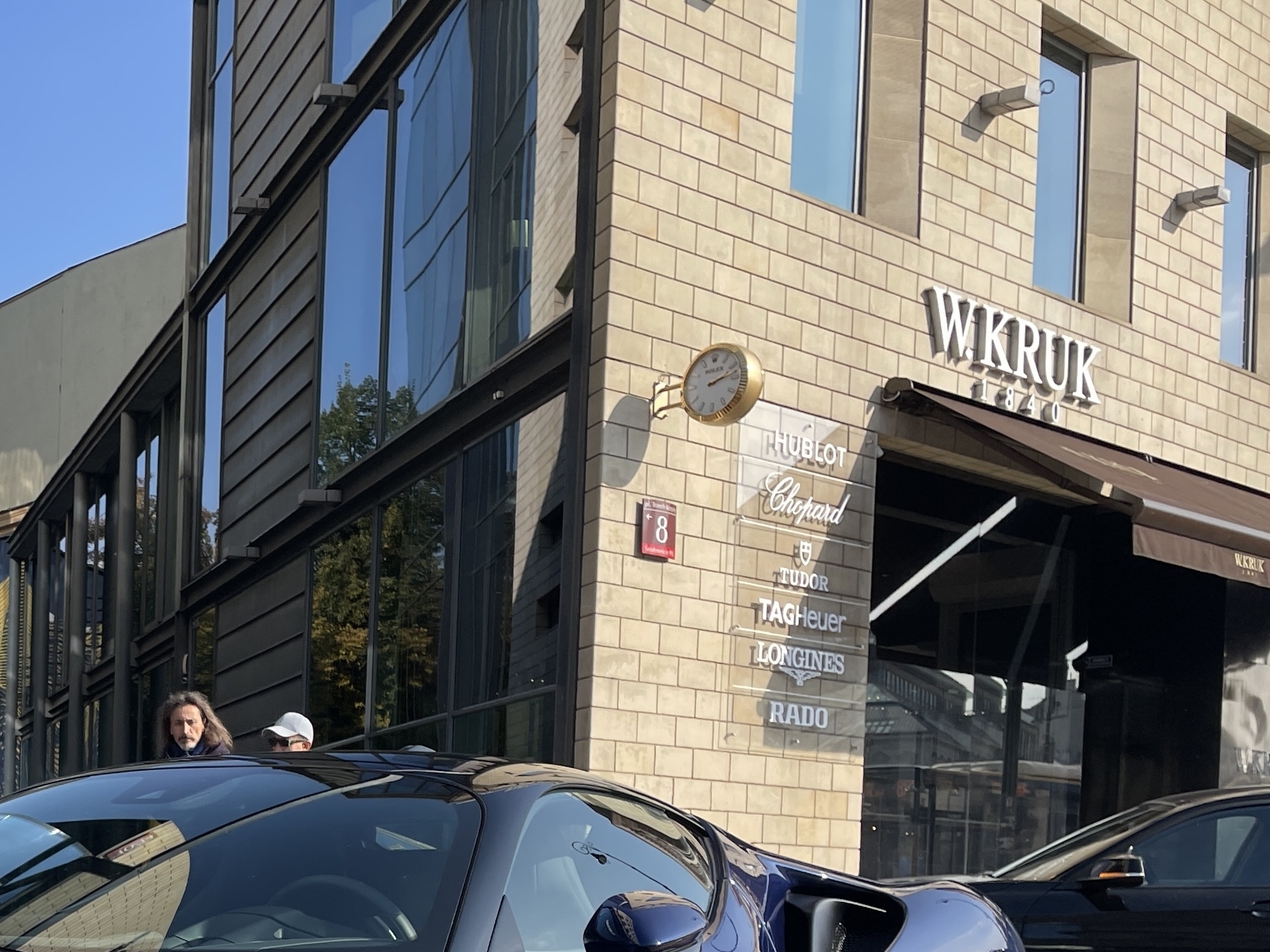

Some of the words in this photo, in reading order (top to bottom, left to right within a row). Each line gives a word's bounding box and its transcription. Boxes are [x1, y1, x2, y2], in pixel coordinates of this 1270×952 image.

[930, 285, 1102, 404] W.KRUK
[979, 377, 1061, 423] 1840
[774, 429, 847, 467] HUBLOT
[765, 471, 851, 525] Chopard
[655, 515, 668, 543] 8
[780, 567, 829, 592] TUDOR
[757, 641, 845, 674] LONGINES
[769, 700, 829, 729] RADO
